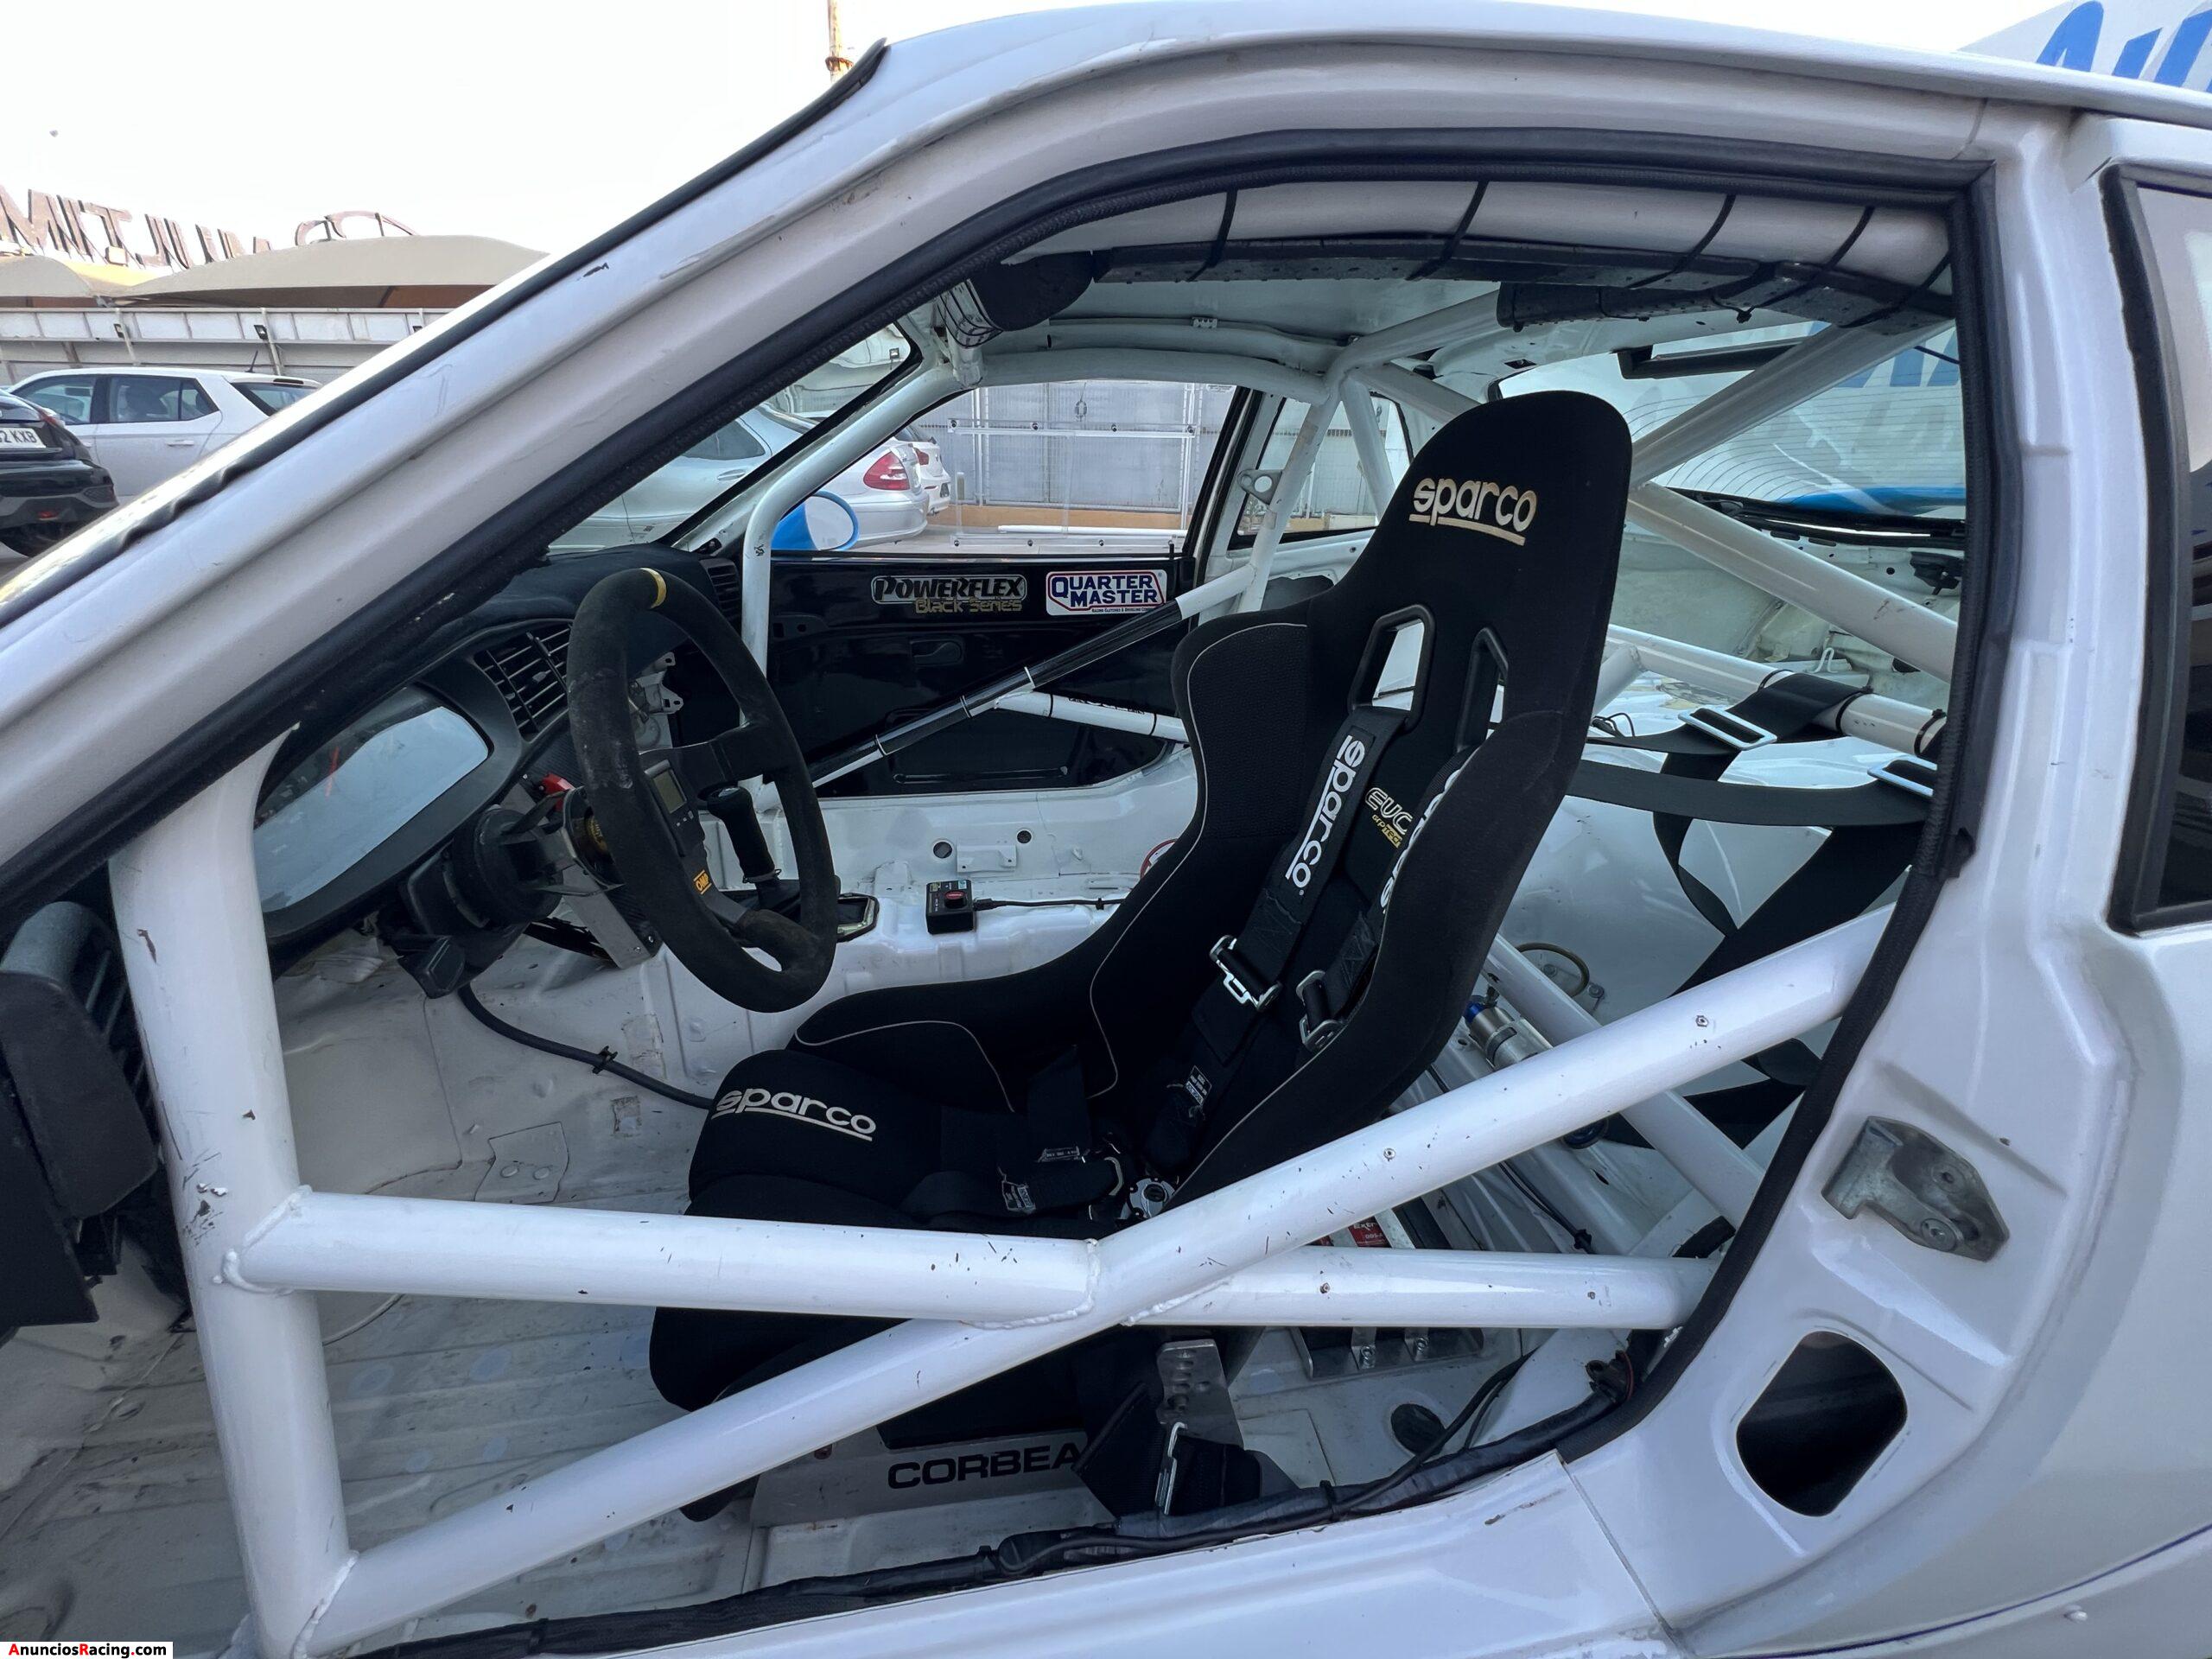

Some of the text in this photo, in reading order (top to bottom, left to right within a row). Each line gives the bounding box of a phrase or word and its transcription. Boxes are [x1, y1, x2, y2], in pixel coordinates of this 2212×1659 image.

[9, 429, 37, 443] KXB
[1413, 477, 1537, 532] sparco
[874, 576, 1026, 601] POWERFLEX
[1052, 575, 1154, 598] QUARTER
[1070, 589, 1158, 607] MASTER
[915, 597, 1022, 613] Black Series
[1292, 738, 1365, 888] sparco
[716, 1088, 876, 1135] sparco
[888, 1442, 1081, 1489] CORBEA
